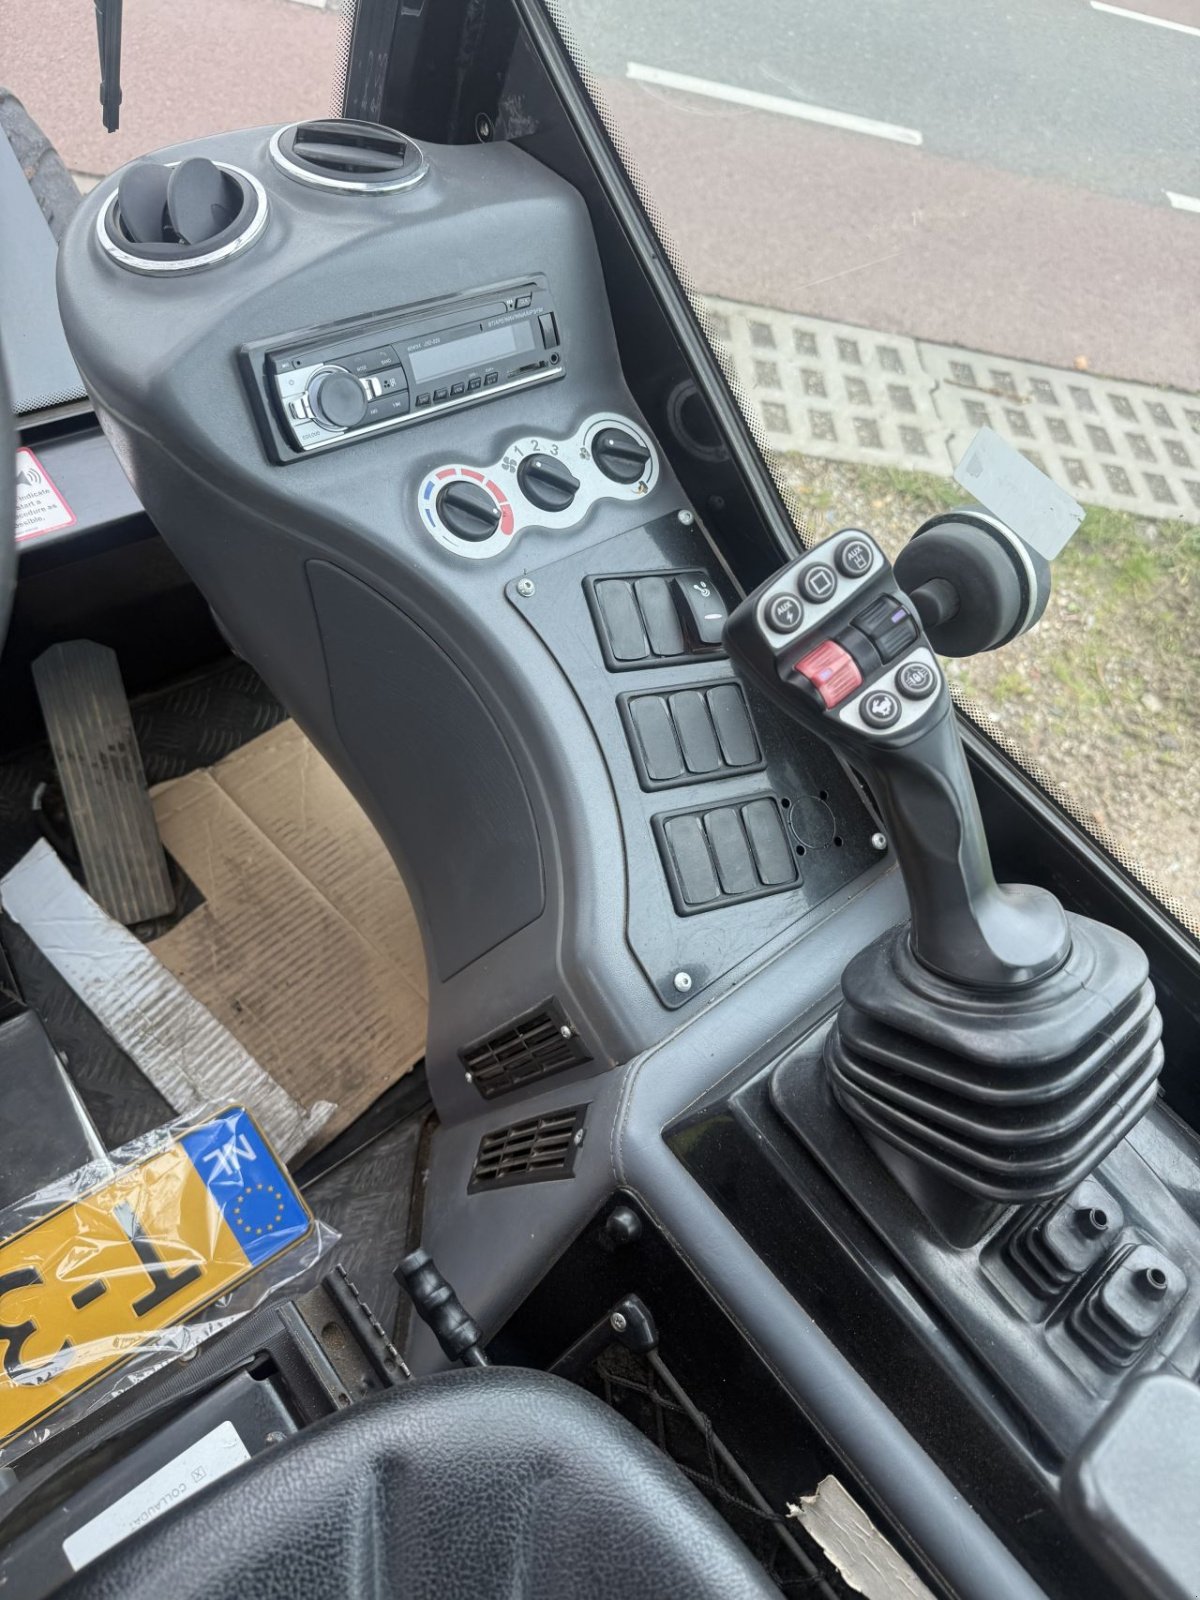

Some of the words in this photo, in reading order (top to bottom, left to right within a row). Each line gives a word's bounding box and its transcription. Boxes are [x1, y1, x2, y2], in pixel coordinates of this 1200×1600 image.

[514, 445, 525, 457] 1
[530, 439, 541, 452] 2
[549, 443, 560, 456] 3
[847, 547, 862, 560] AUX
[777, 602, 792, 615] AUX
[203, 1133, 257, 1176] NL
